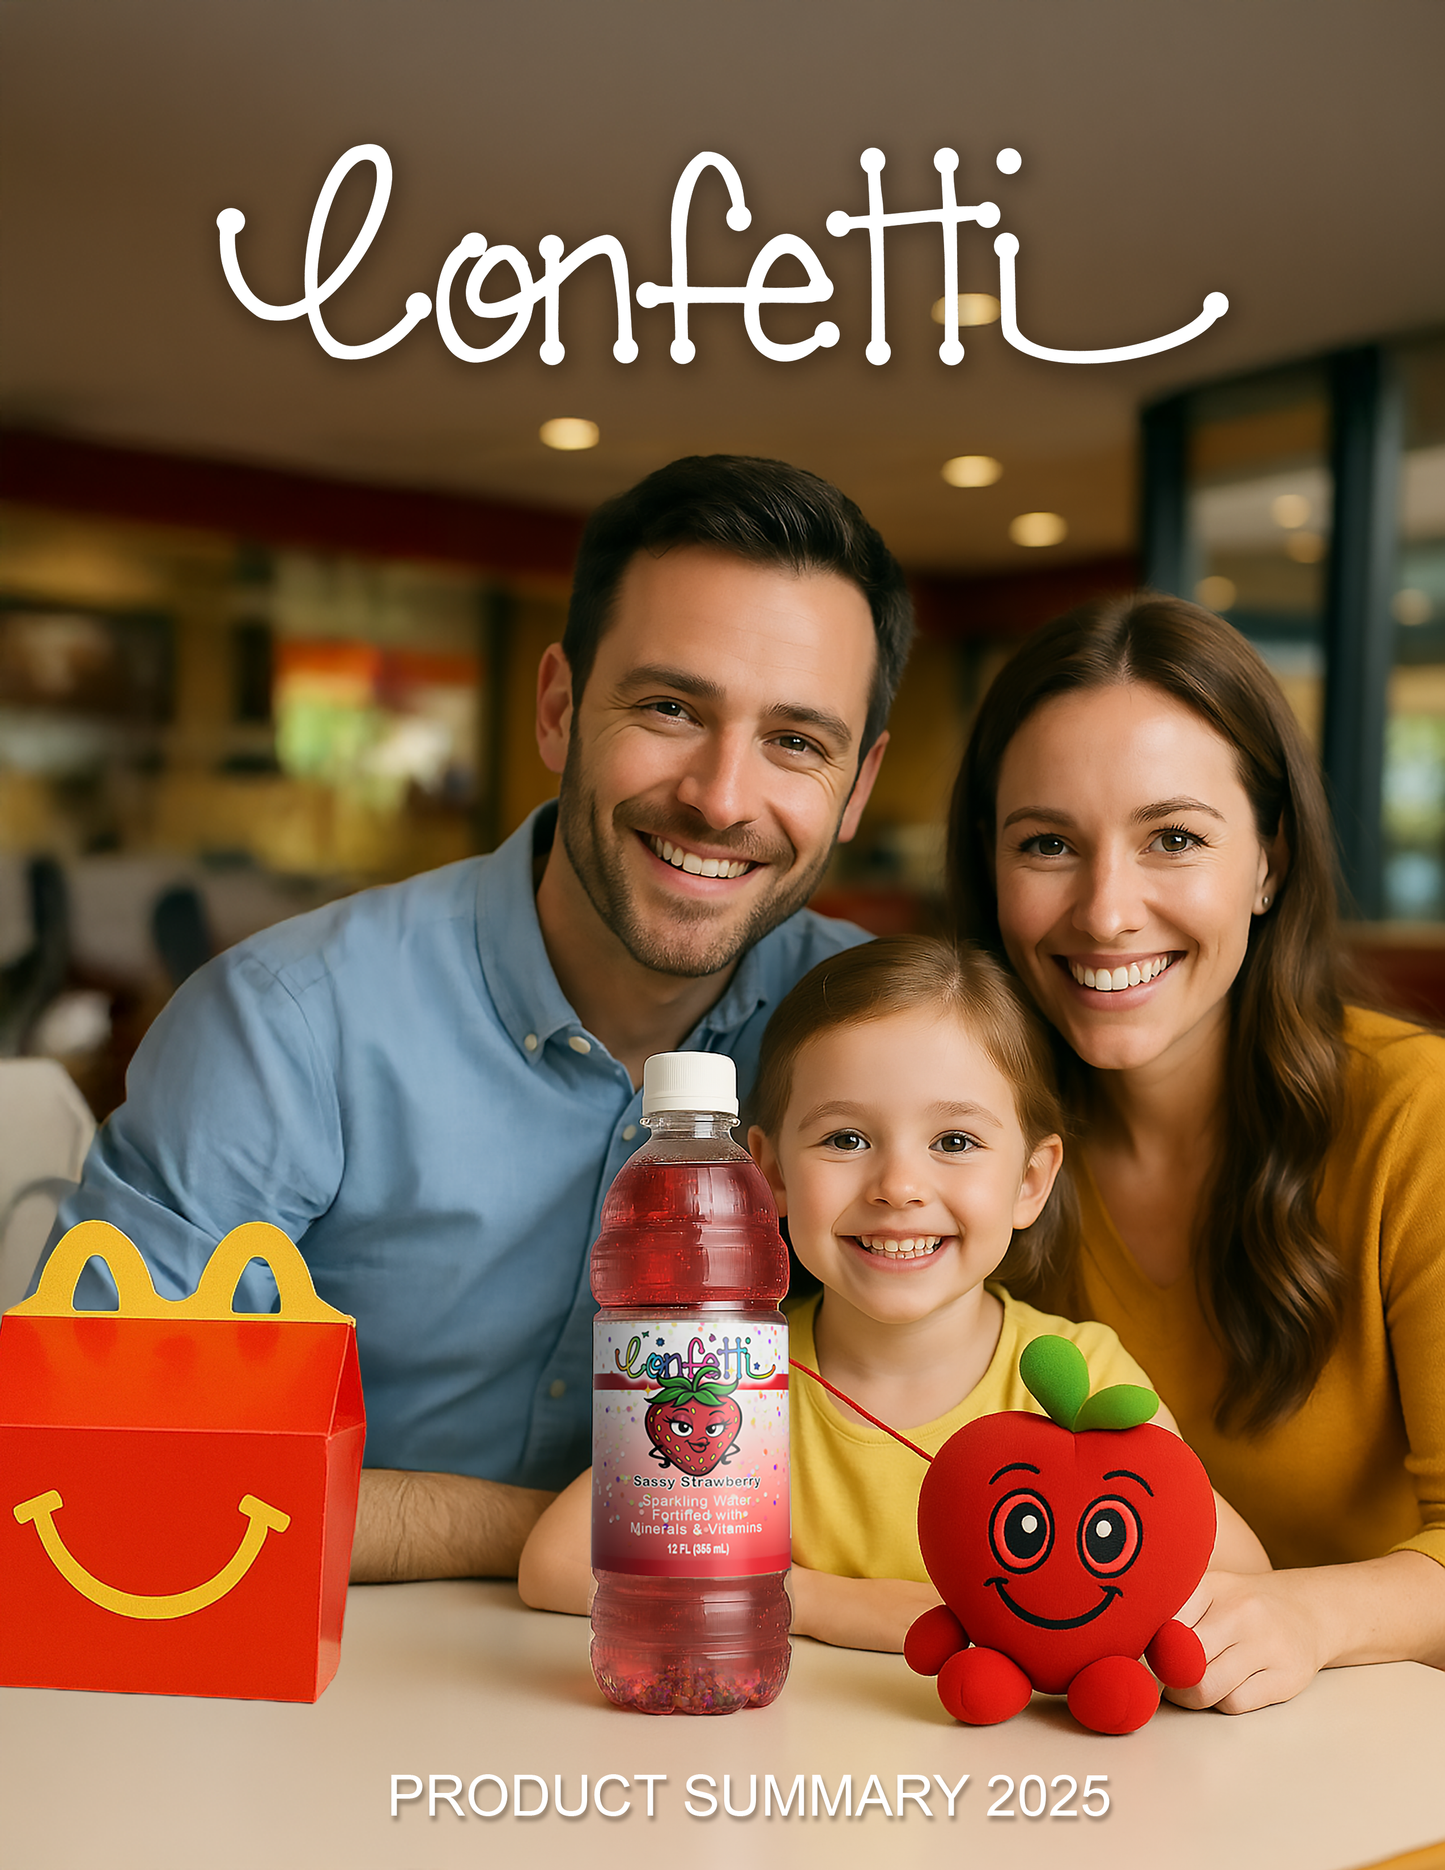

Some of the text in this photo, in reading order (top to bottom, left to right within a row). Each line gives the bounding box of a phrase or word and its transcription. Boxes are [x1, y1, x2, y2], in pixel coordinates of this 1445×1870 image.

[633, 1475, 761, 1490] Sassy Strawberry
[642, 1494, 751, 1509] Sparkling Water
[652, 1508, 742, 1521] Fortified with
[630, 1522, 763, 1535] Minerals & Vitamins
[667, 1543, 730, 1556] 12 FL (355 mL)
